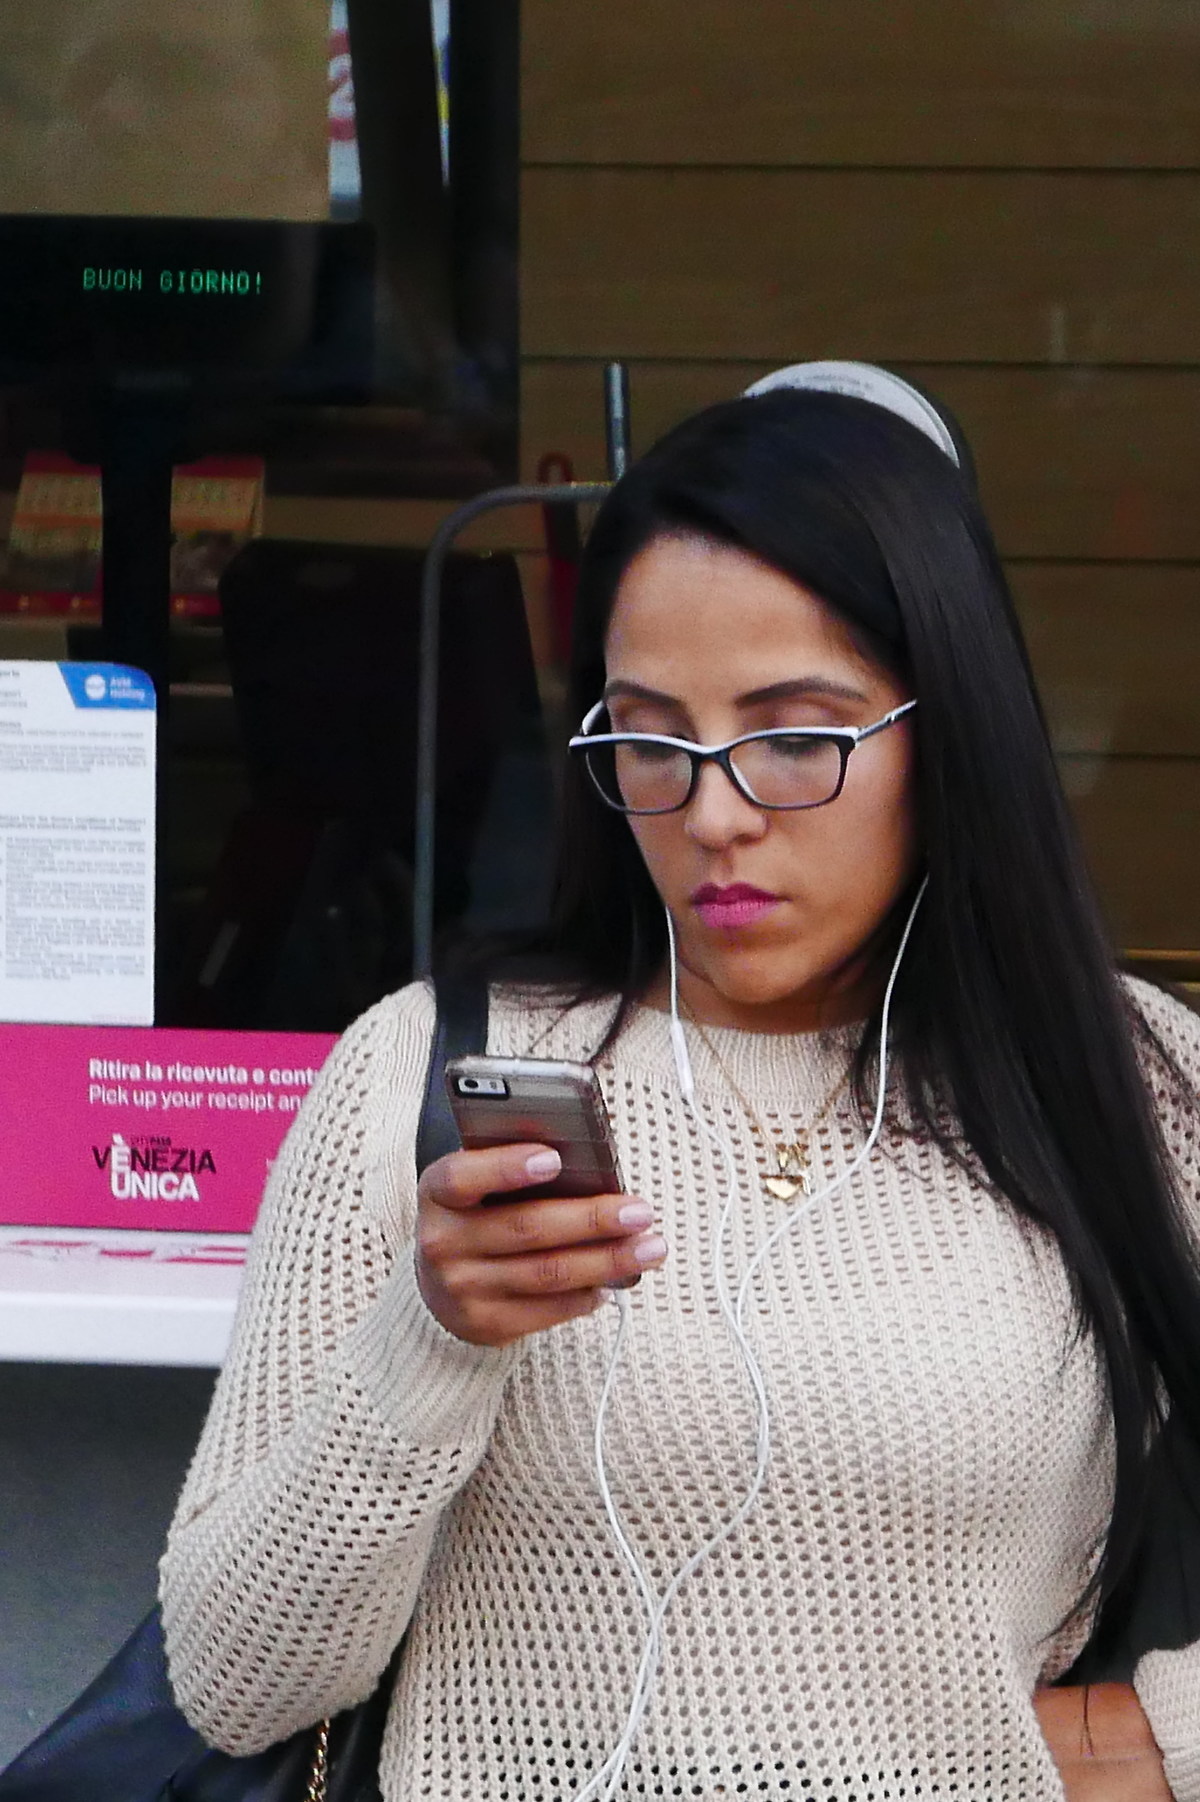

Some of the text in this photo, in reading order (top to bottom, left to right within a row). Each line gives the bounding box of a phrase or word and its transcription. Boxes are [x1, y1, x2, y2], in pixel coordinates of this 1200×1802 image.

[83, 267, 262, 295] BUON GIORNO!
[88, 1058, 141, 1080] Ritira
[145, 1060, 164, 1081] la
[168, 1062, 248, 1085] ricevuta
[252, 1066, 265, 1085] e
[88, 1084, 303, 1114] Pick up your receipt an
